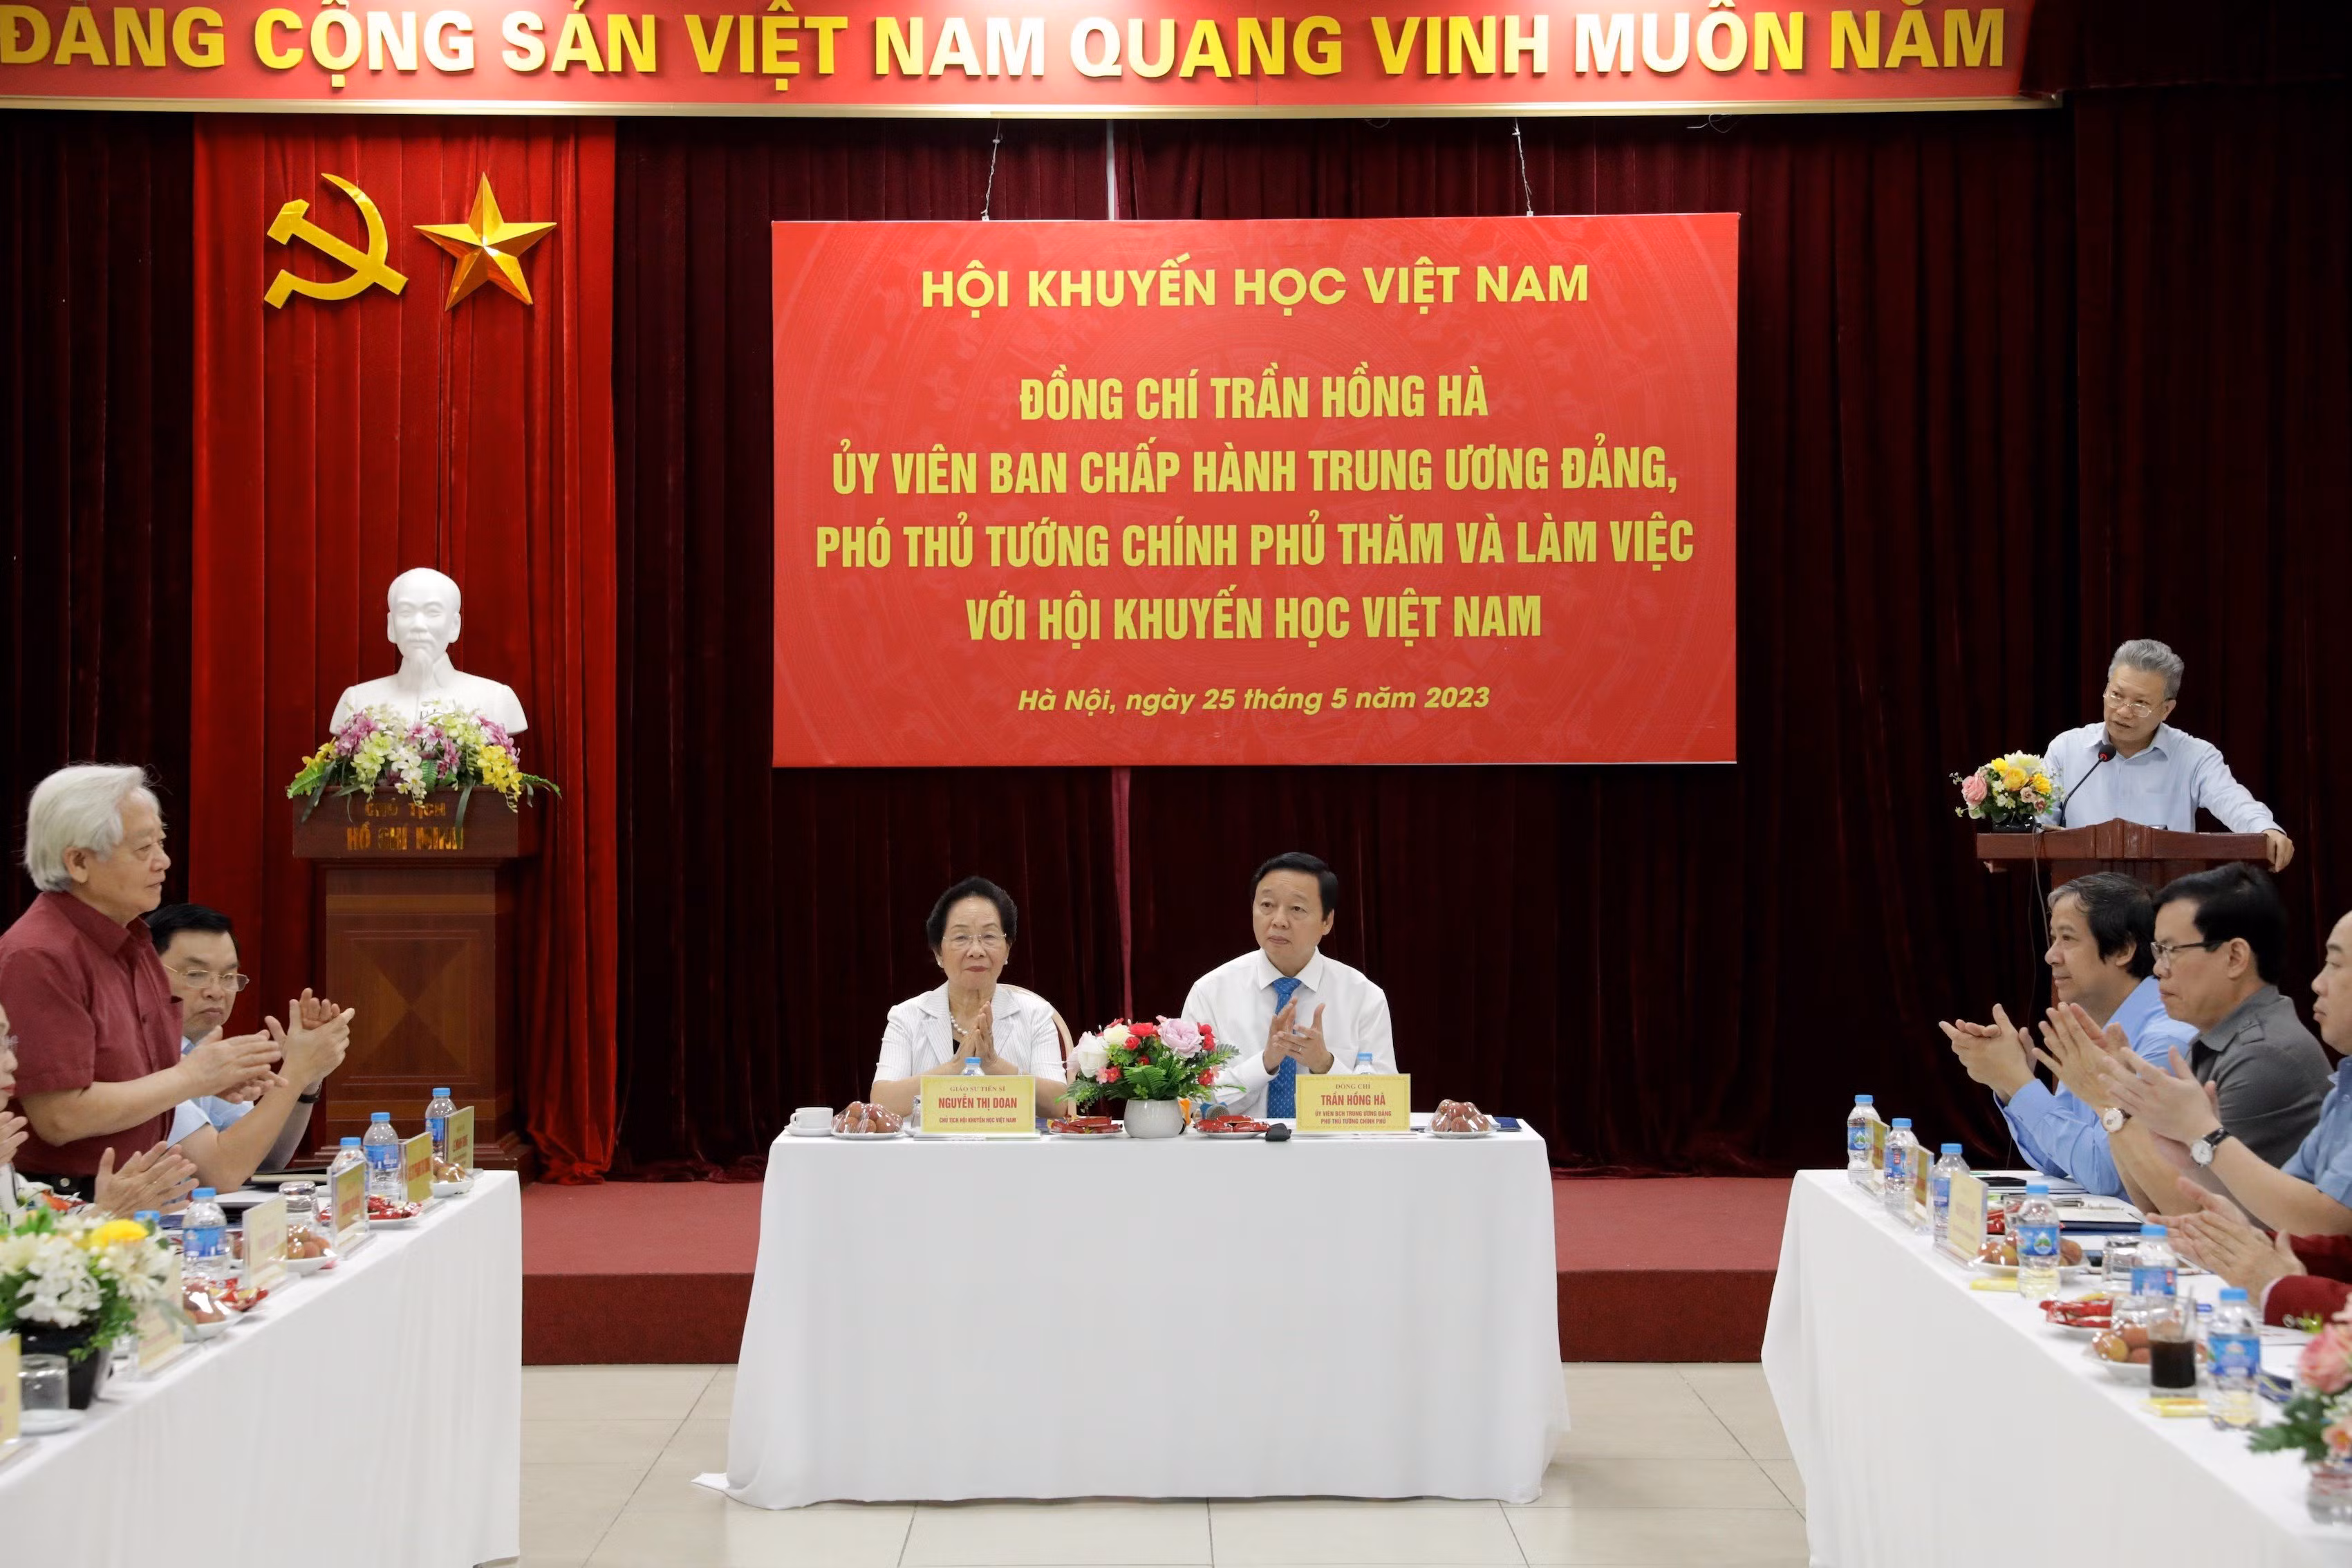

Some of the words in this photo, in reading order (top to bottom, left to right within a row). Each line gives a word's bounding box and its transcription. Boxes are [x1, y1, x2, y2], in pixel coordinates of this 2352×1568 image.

[254, 0, 475, 88] CỘNG
[503, 0, 656, 73] SẢN
[684, 0, 848, 91] VIỆT
[875, 17, 1045, 76] NAM
[1070, 15, 1342, 78] QUANG
[1372, 15, 1549, 74] VINH
[1576, 0, 1803, 73] MUÔN
[922, 259, 1009, 319] HỘI
[1028, 252, 1215, 308] KHUYẾN
[1234, 267, 1347, 317] HỌC
[1362, 256, 1461, 315] VIỆT
[1476, 264, 1588, 303] NAM
[1019, 364, 1123, 421] ĐỒNG
[1136, 368, 1200, 420] CHÍ
[1210, 362, 1309, 419] TRẦN
[1322, 361, 1425, 418] HỒNG
[1438, 365, 1488, 417] HÀ
[833, 438, 880, 495] ỦY
[891, 443, 977, 494] VIÊN
[990, 451, 1067, 494] BAN
[1080, 436, 1180, 494] CHẤP
[1193, 442, 1296, 492] HÀNH
[1307, 449, 1432, 492] TRUNG
[1446, 443, 1549, 491] ƯƠNG
[1560, 432, 1677, 494] ĐẢNG,
[816, 517, 890, 568] PHÓ
[903, 511, 973, 568] THỦ
[985, 516, 1109, 568] TƯỚNG
[1122, 516, 1237, 567] CHÍNH
[1251, 509, 1325, 566] PHỦ
[1337, 514, 1443, 565] THĂM
[1456, 513, 1505, 563] VÀ
[1517, 512, 1596, 563] LÀM
[1609, 511, 1694, 571] VIỆC
[966, 590, 1025, 641] VỚI
[1039, 590, 1100, 650] HỘI
[1114, 584, 1262, 640] KHUYẾN
[1276, 596, 1350, 648] HỌC
[1362, 587, 1441, 647] VIỆT
[1454, 595, 1541, 637] NAM
[1018, 688, 1056, 711] Hà
[1064, 688, 1117, 717] Nội,
[1126, 687, 1196, 716] ngày
[1202, 688, 1235, 709] 25
[1244, 686, 1323, 716] tháng
[1331, 688, 1347, 709] 5
[1355, 687, 1416, 709] năm
[1424, 687, 1490, 709] 2023
[347, 821, 371, 850] HỒ
[938, 1093, 974, 1108] NGUYỄN
[976, 1097, 990, 1111] THỊ
[993, 1097, 1017, 1108] DOAN
[1374, 1092, 1385, 1105] HÀ
